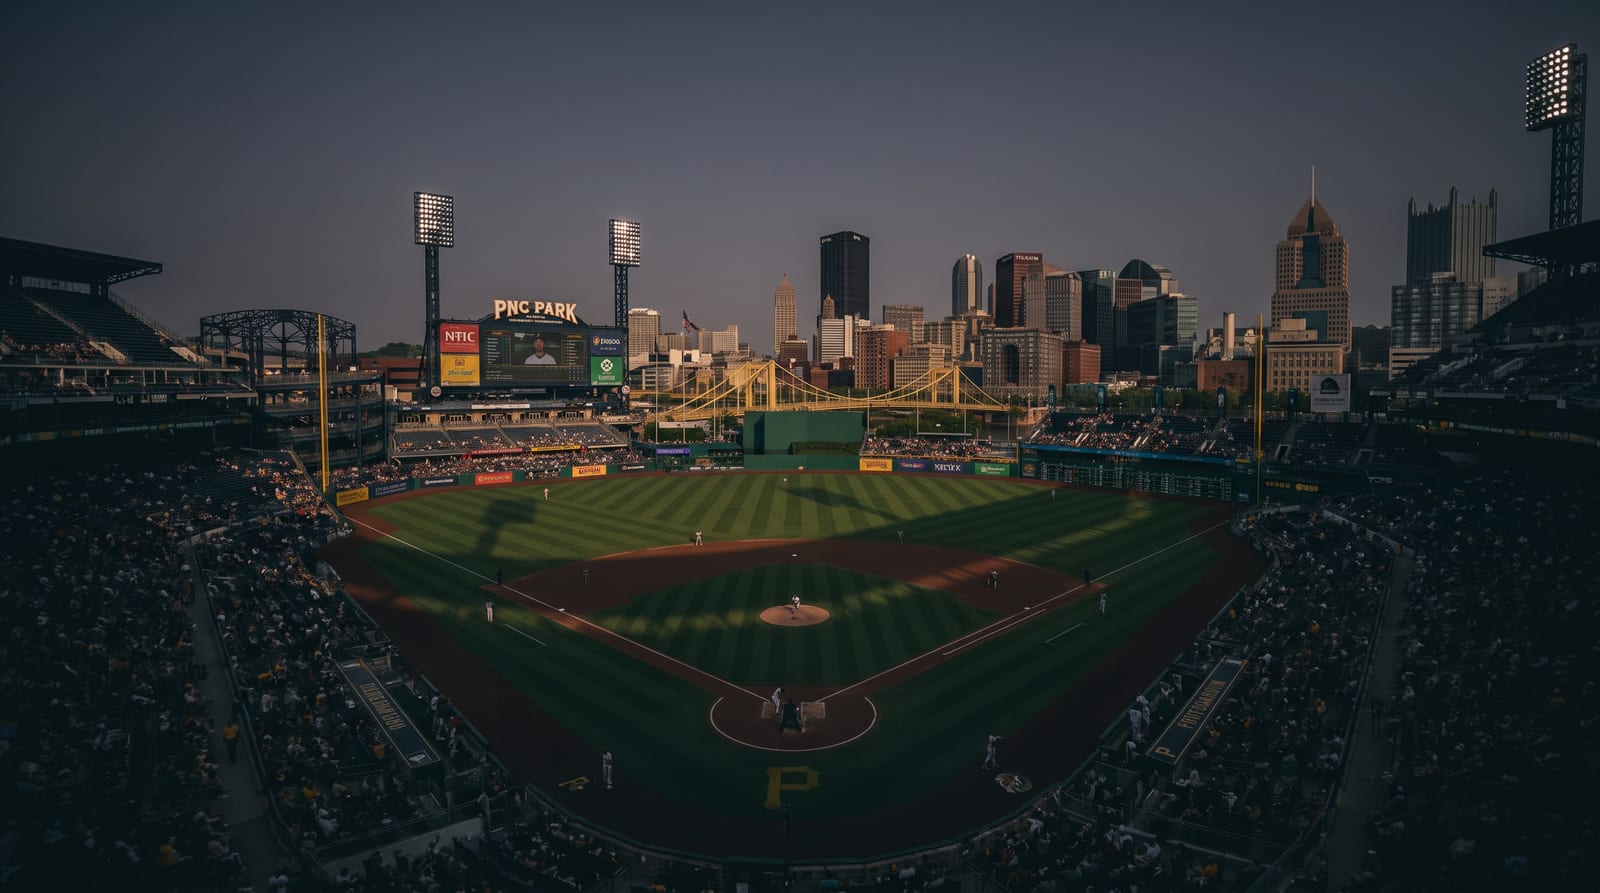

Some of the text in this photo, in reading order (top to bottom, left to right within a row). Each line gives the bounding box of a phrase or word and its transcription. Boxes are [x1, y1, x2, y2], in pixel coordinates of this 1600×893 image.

[494, 299, 530, 320] PNC
[534, 301, 579, 325] PARK
[763, 766, 821, 810] P
